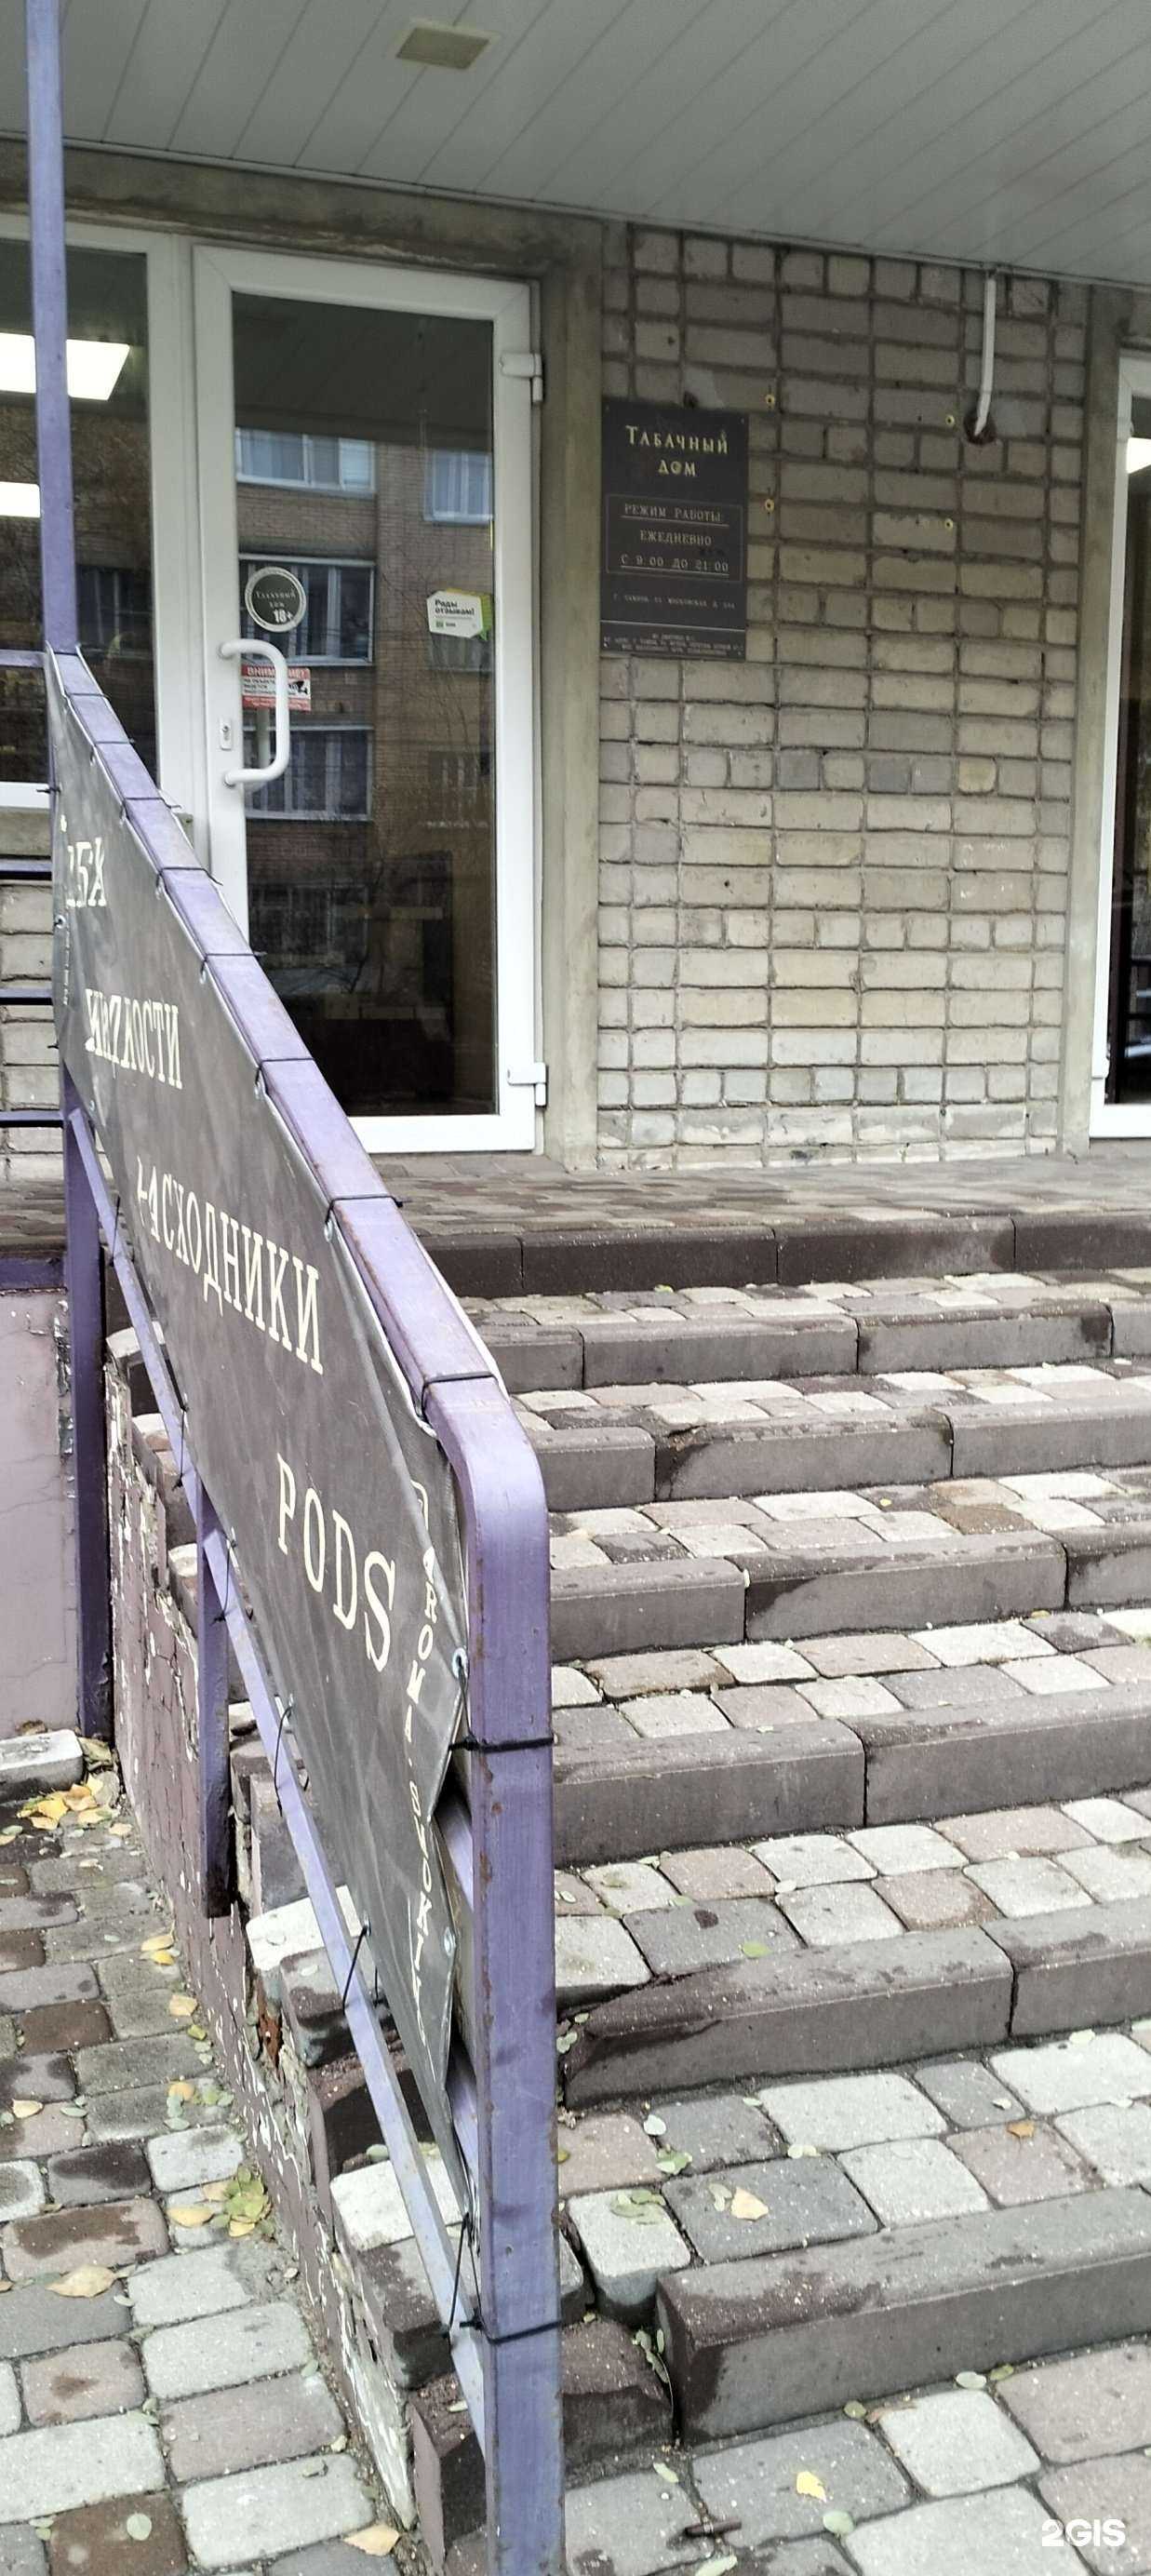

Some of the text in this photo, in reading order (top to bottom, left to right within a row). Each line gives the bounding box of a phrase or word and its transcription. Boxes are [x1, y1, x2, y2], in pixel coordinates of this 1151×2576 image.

[624, 503, 666, 518] РЕЖИМ
[640, 530, 712, 546] ЕЖЕДНЕВНО
[621, 554, 629, 565] С
[672, 558, 689, 570] ДО
[435, 598, 458, 608] Рады
[274, 609, 293, 623] 18+
[435, 607, 475, 615] отзывам!
[277, 1453, 395, 1672] PODS
